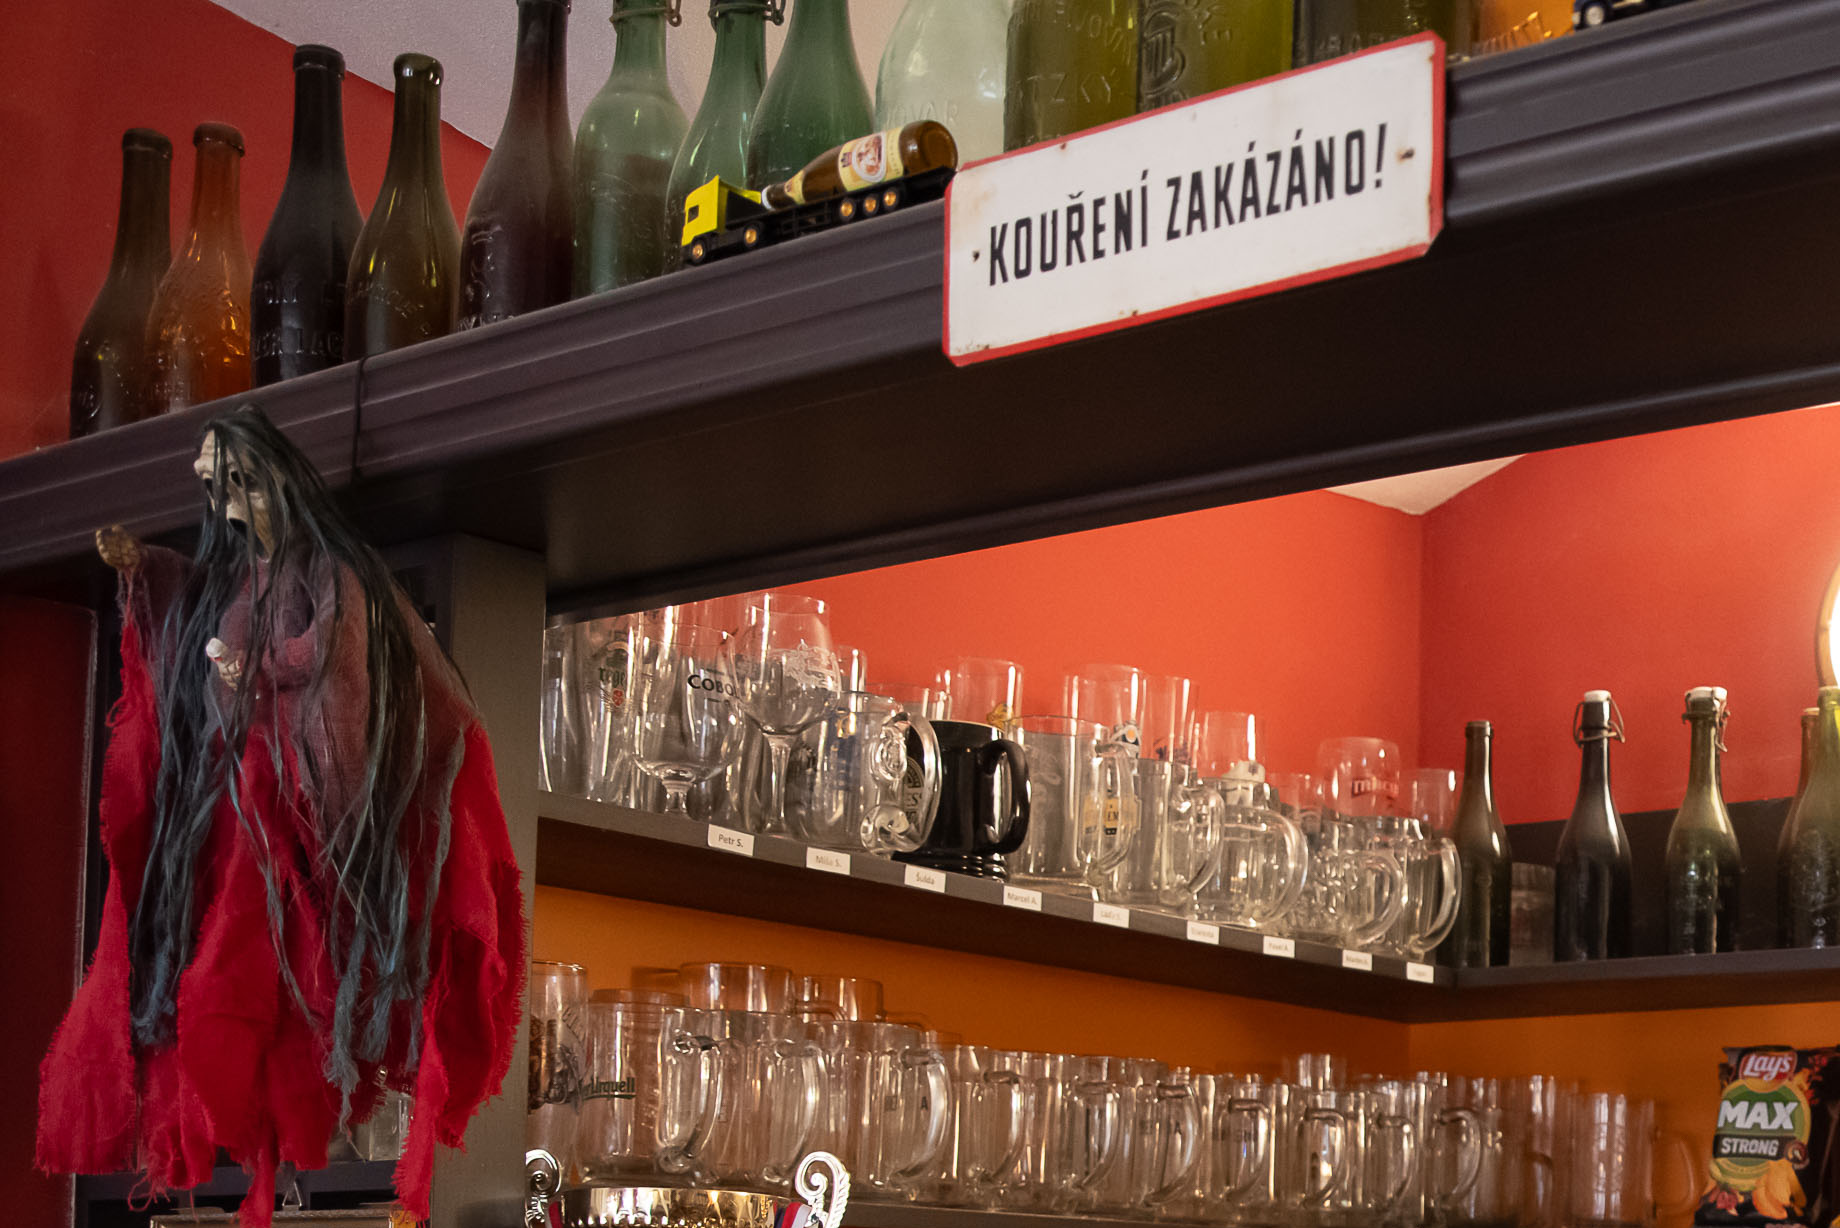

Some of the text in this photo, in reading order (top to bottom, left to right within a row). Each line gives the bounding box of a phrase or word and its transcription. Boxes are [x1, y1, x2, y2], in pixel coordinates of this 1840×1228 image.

[988, 122, 1388, 286] KOUŘENÍ ZAKÁZÁNO!
[1743, 1054, 1793, 1080] Lay's
[1717, 1101, 1798, 1130] MAX
[1721, 1138, 1779, 1157] STRONG
